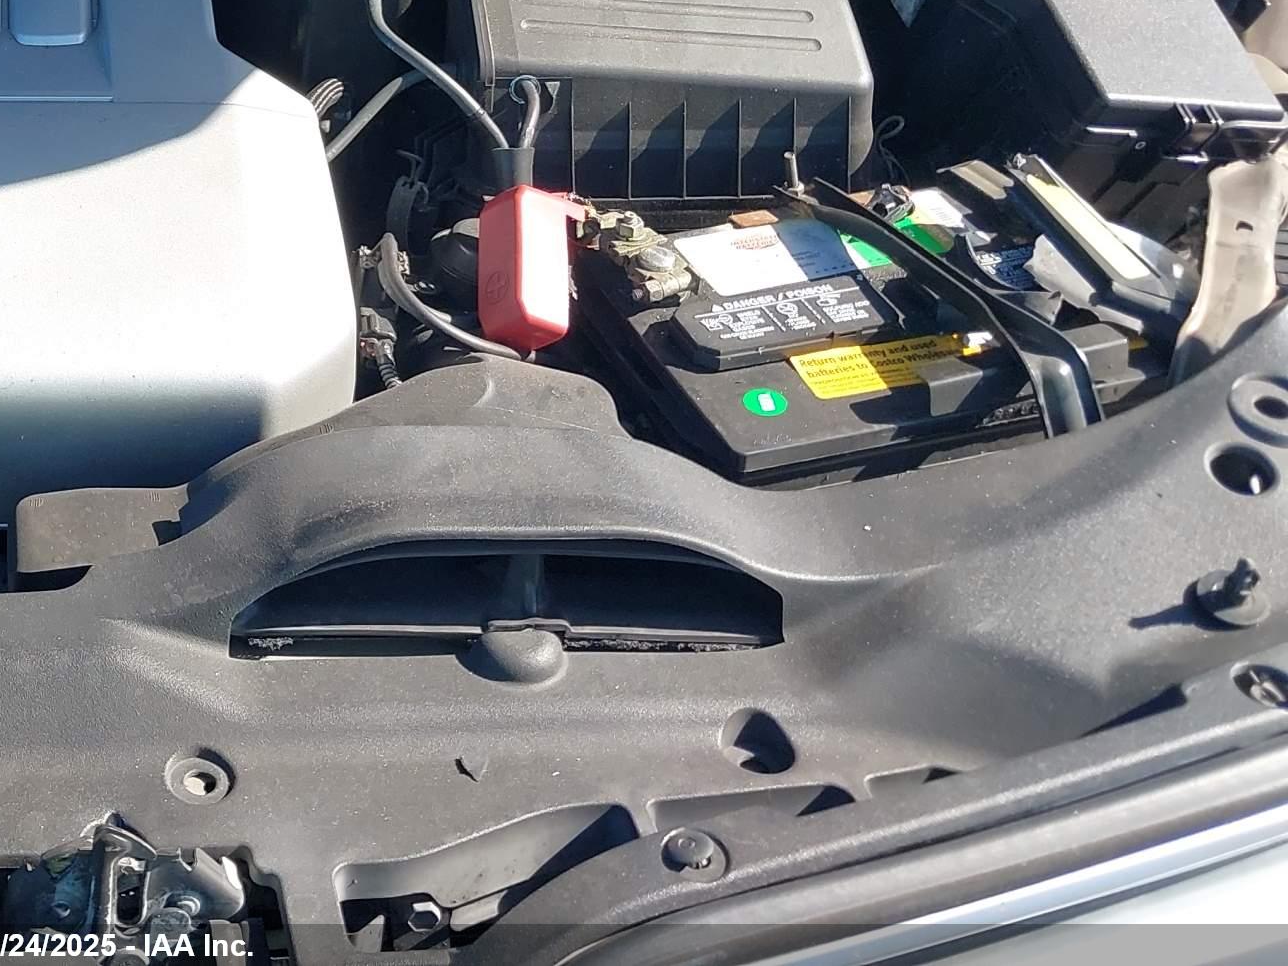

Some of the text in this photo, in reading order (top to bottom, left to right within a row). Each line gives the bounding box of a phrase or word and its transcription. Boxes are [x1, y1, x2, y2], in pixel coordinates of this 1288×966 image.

[726, 295, 778, 311] DANGER
[784, 284, 834, 299] POISON
[799, 356, 836, 367] Return
[888, 344, 909, 354] and
[910, 339, 937, 350] used
[806, 366, 855, 378] batteries
